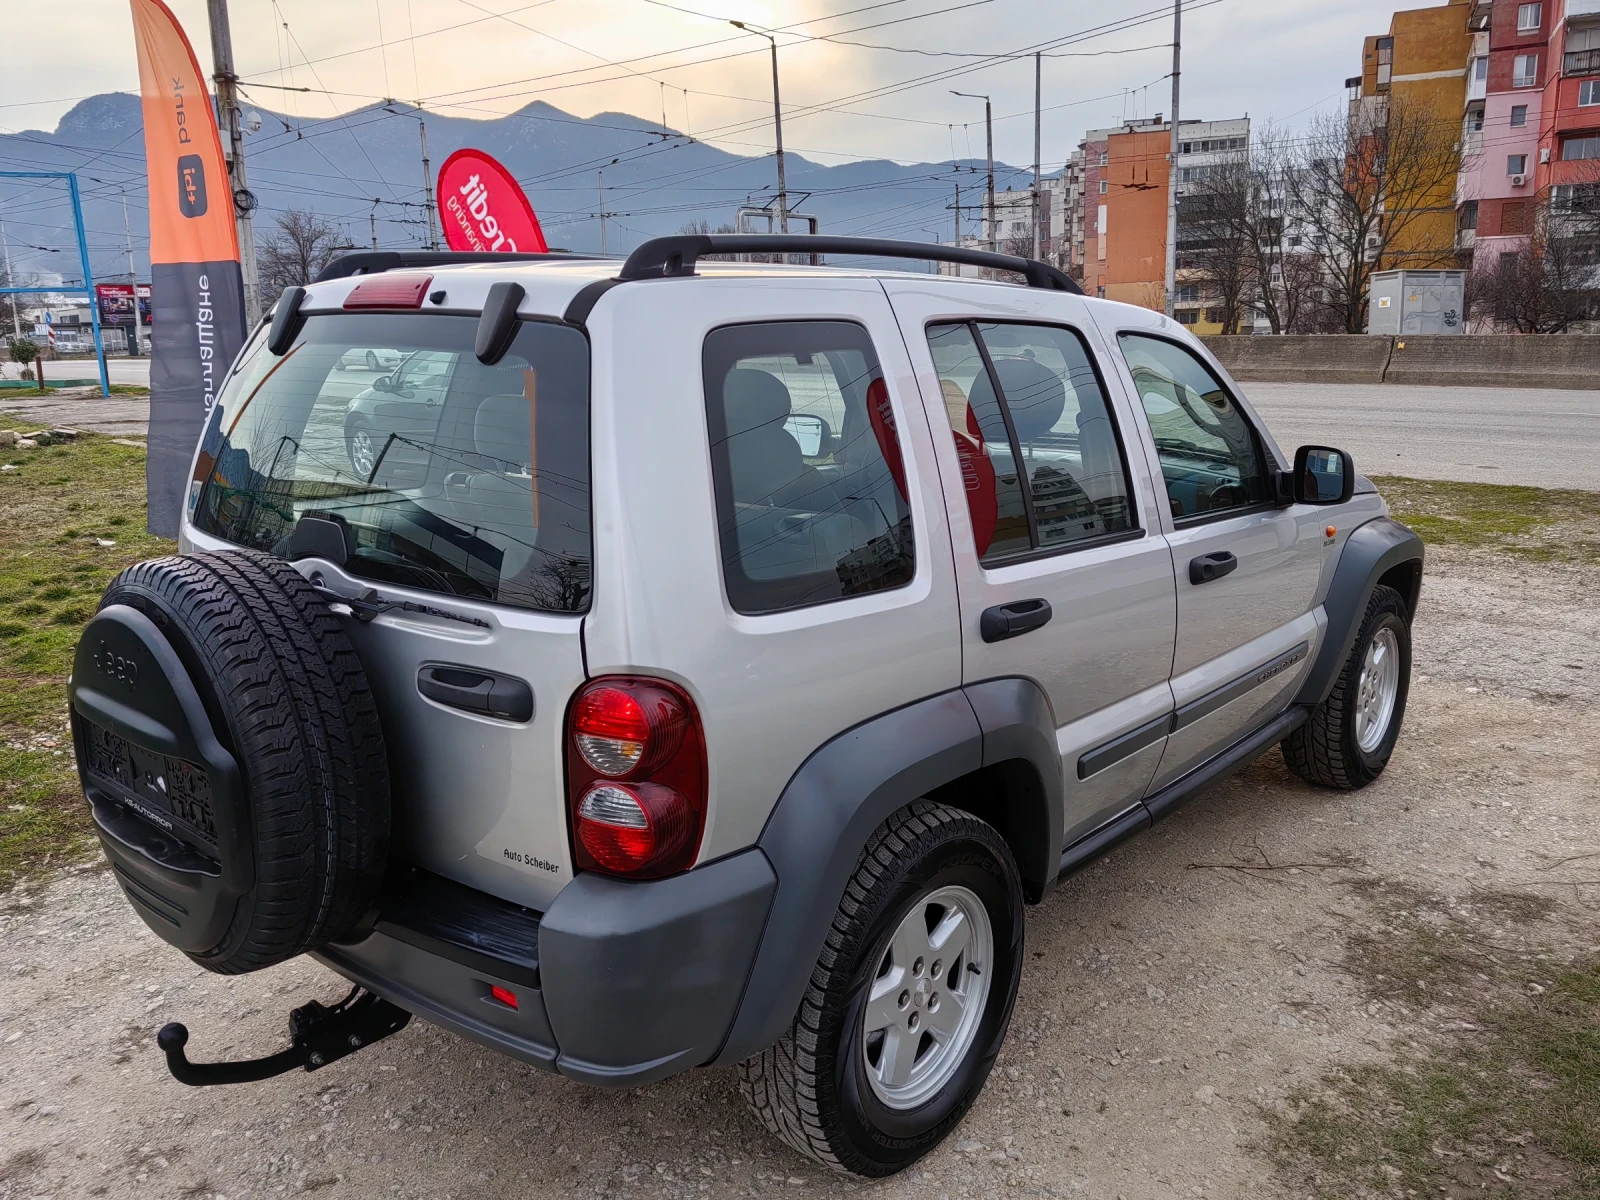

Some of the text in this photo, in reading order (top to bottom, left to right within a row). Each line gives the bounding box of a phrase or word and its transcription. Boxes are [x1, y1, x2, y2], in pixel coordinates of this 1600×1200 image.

[93, 639, 138, 691] Jeep
[503, 848, 560, 873] Auto Scheiber
